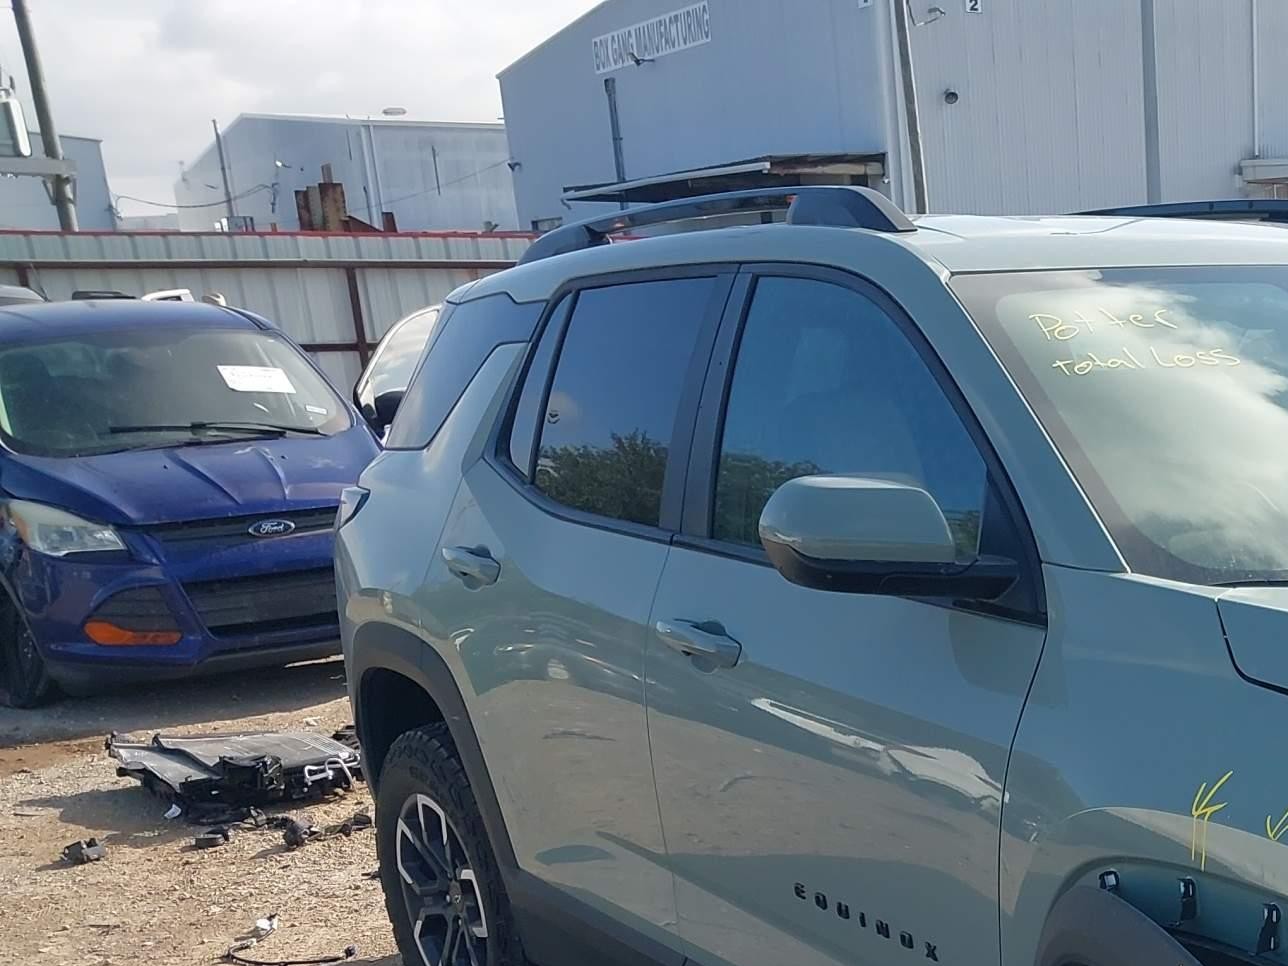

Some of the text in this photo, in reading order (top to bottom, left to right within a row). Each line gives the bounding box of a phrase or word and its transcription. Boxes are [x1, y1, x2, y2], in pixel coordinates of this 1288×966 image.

[593, 4, 710, 71] BOX GANG MANUFACTURING
[1029, 308, 1178, 341] Potter
[794, 882, 939, 962] EQUINOX
